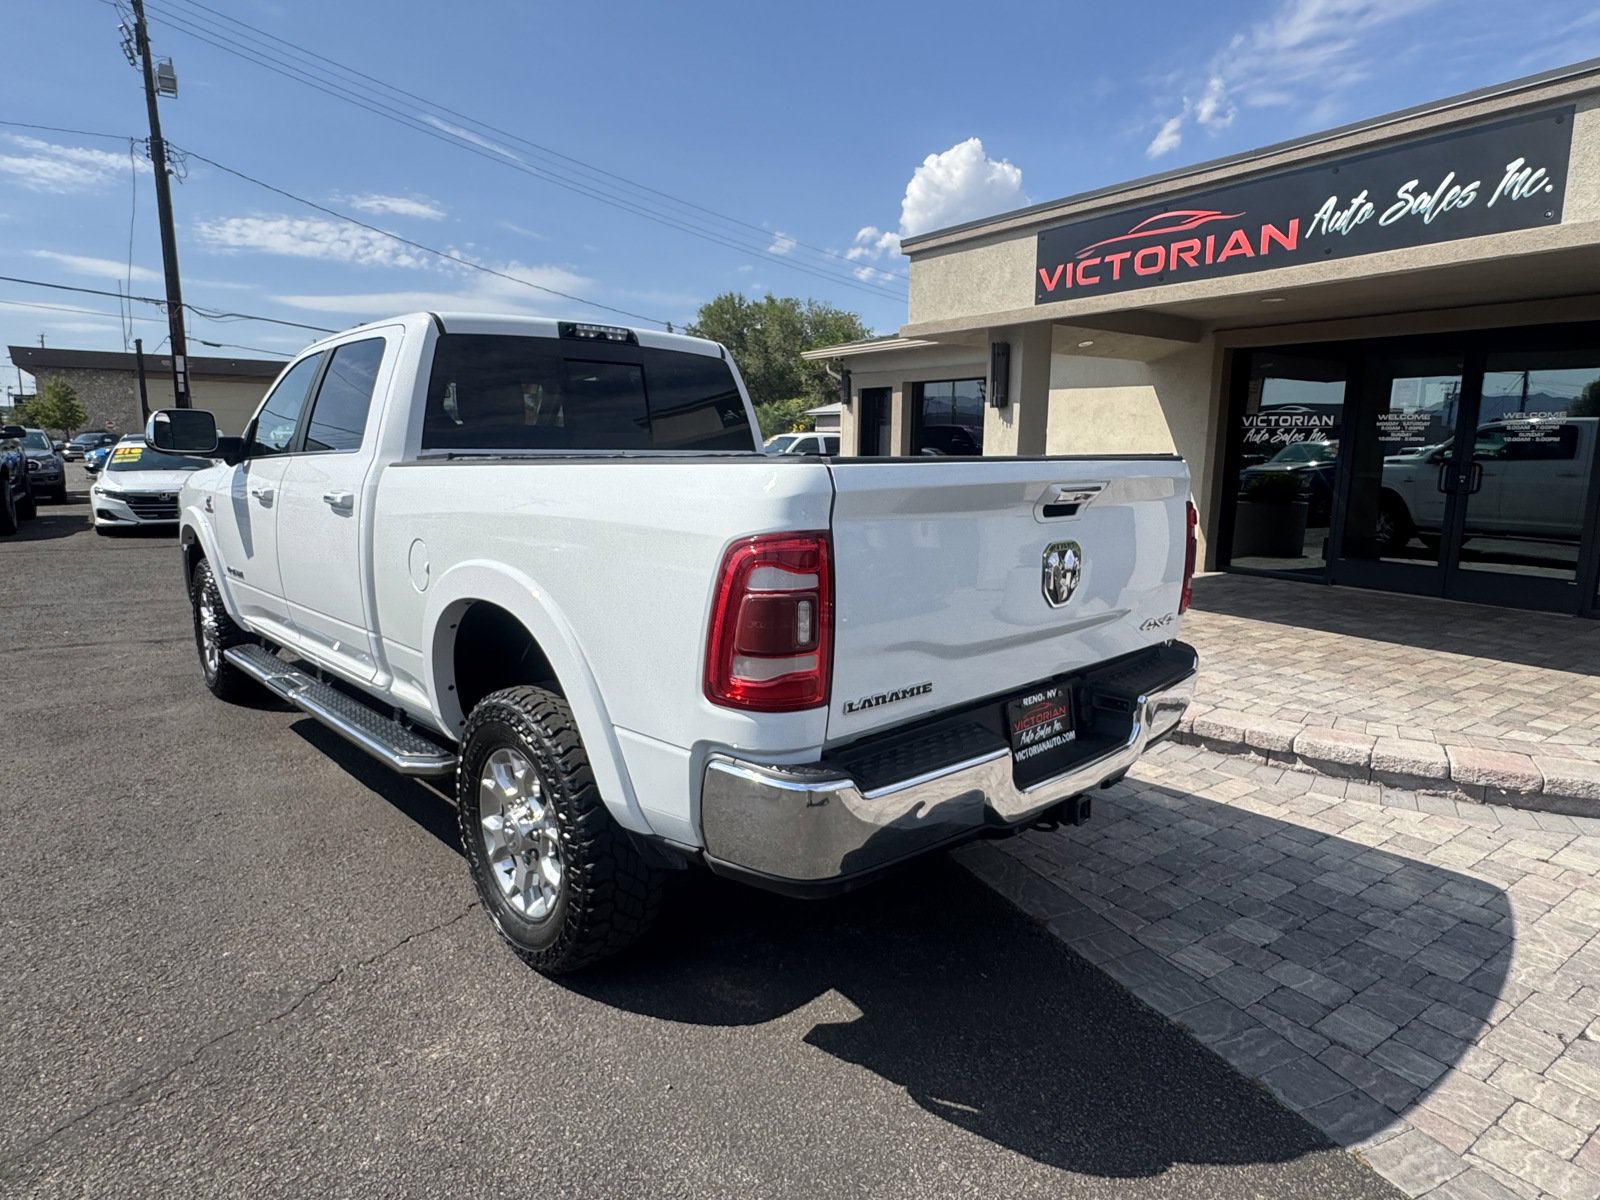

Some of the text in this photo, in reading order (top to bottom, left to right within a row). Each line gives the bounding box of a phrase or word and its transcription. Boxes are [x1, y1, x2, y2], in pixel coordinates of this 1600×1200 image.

[1038, 157, 1553, 292] VICTORIAN Auto Sales Inc.
[1242, 415, 1335, 427] VICTORIAN
[1503, 411, 1568, 419] WELCOME
[1242, 428, 1269, 444] Auto
[1270, 428, 1305, 446] Sales
[843, 682, 933, 714] LARAMIE
[1046, 688, 1057, 699] NV
[1013, 705, 1067, 731] VICTORIAN
[1020, 729, 1034, 746] Auto
[1034, 723, 1052, 741] Sales
